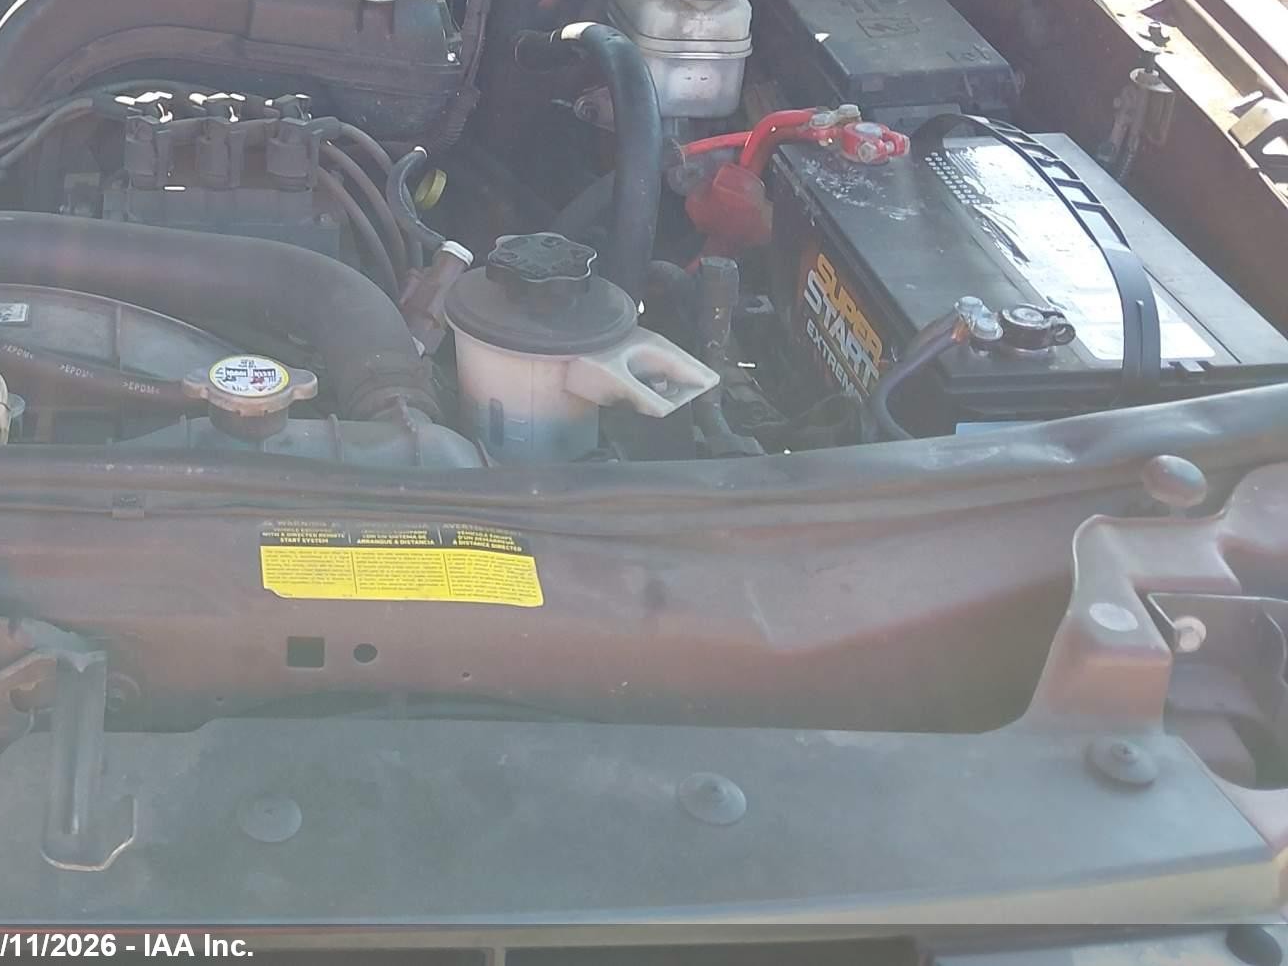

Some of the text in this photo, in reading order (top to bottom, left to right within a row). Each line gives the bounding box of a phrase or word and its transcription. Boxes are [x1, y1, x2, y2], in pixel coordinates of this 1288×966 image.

[804, 269, 880, 388] START
[806, 318, 863, 403] EXTREM
[817, 253, 883, 364] SUPER
